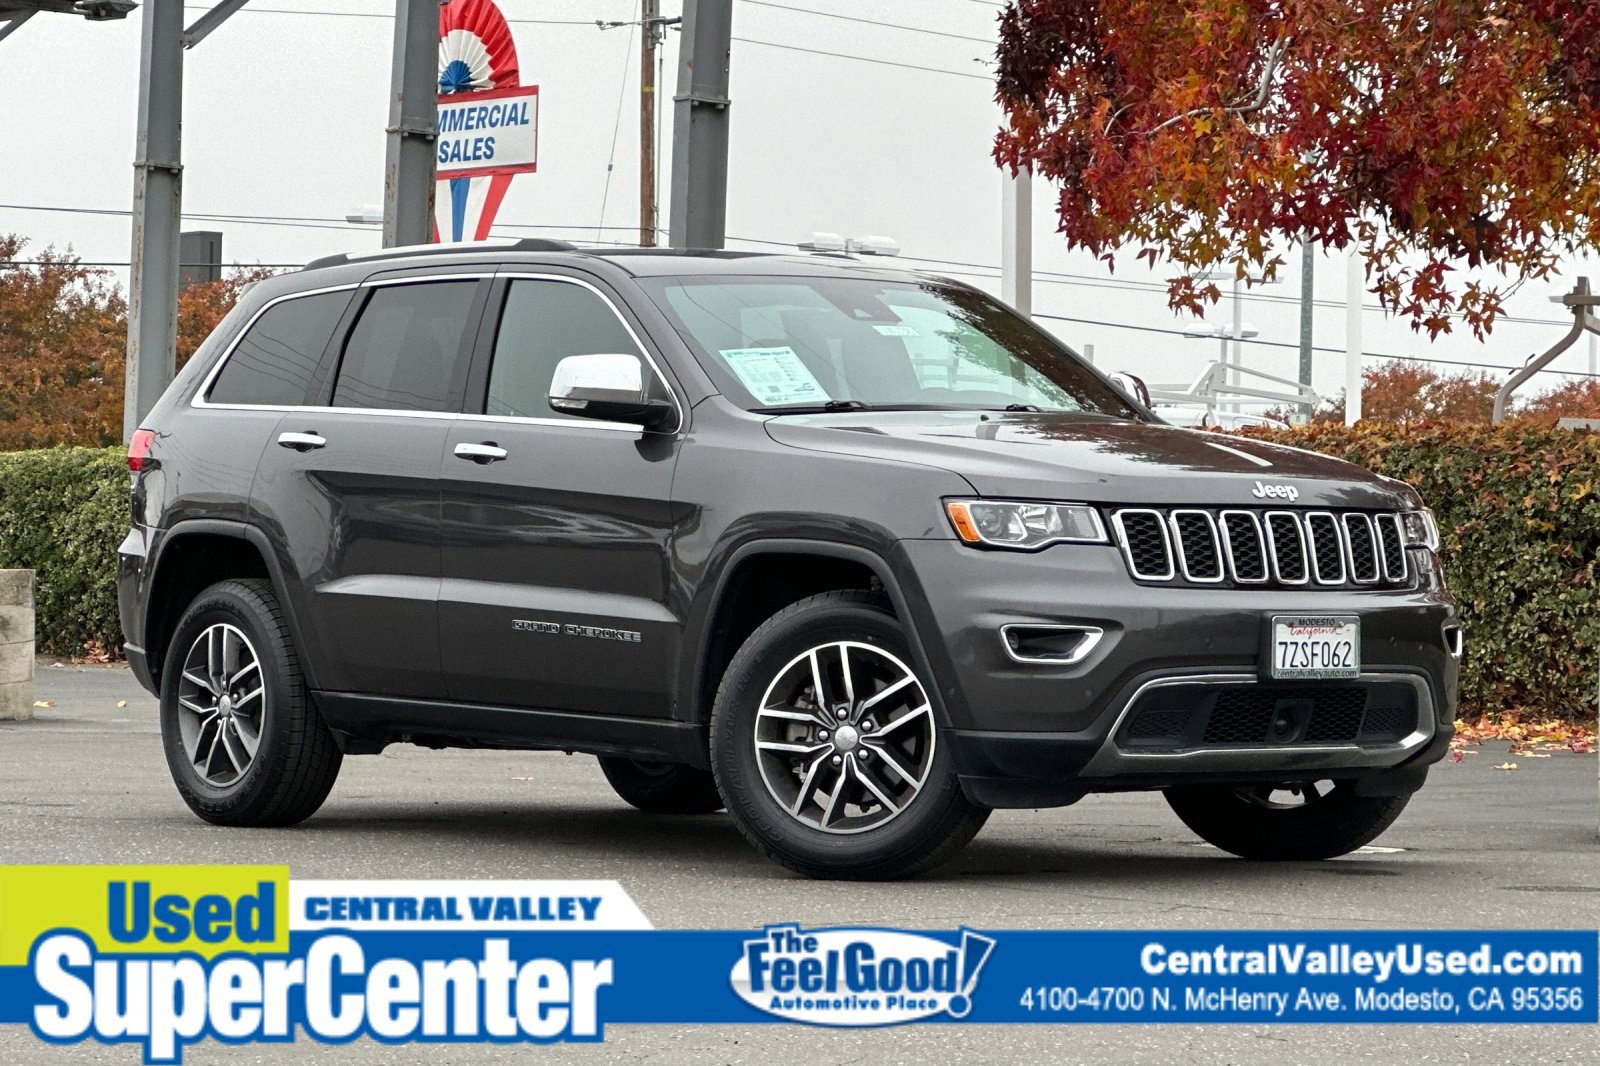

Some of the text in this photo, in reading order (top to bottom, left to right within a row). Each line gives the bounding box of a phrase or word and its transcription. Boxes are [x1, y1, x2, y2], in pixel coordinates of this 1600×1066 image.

[438, 136, 496, 163] SALES
[1252, 481, 1299, 502] Jeep
[512, 619, 642, 643] GRAND CHEROKEE
[1298, 618, 1335, 626] MODESTO
[1289, 626, 1343, 640] California
[1278, 641, 1352, 668] 7ZSF062
[1276, 668, 1357, 679] centralvalleyauto.com
